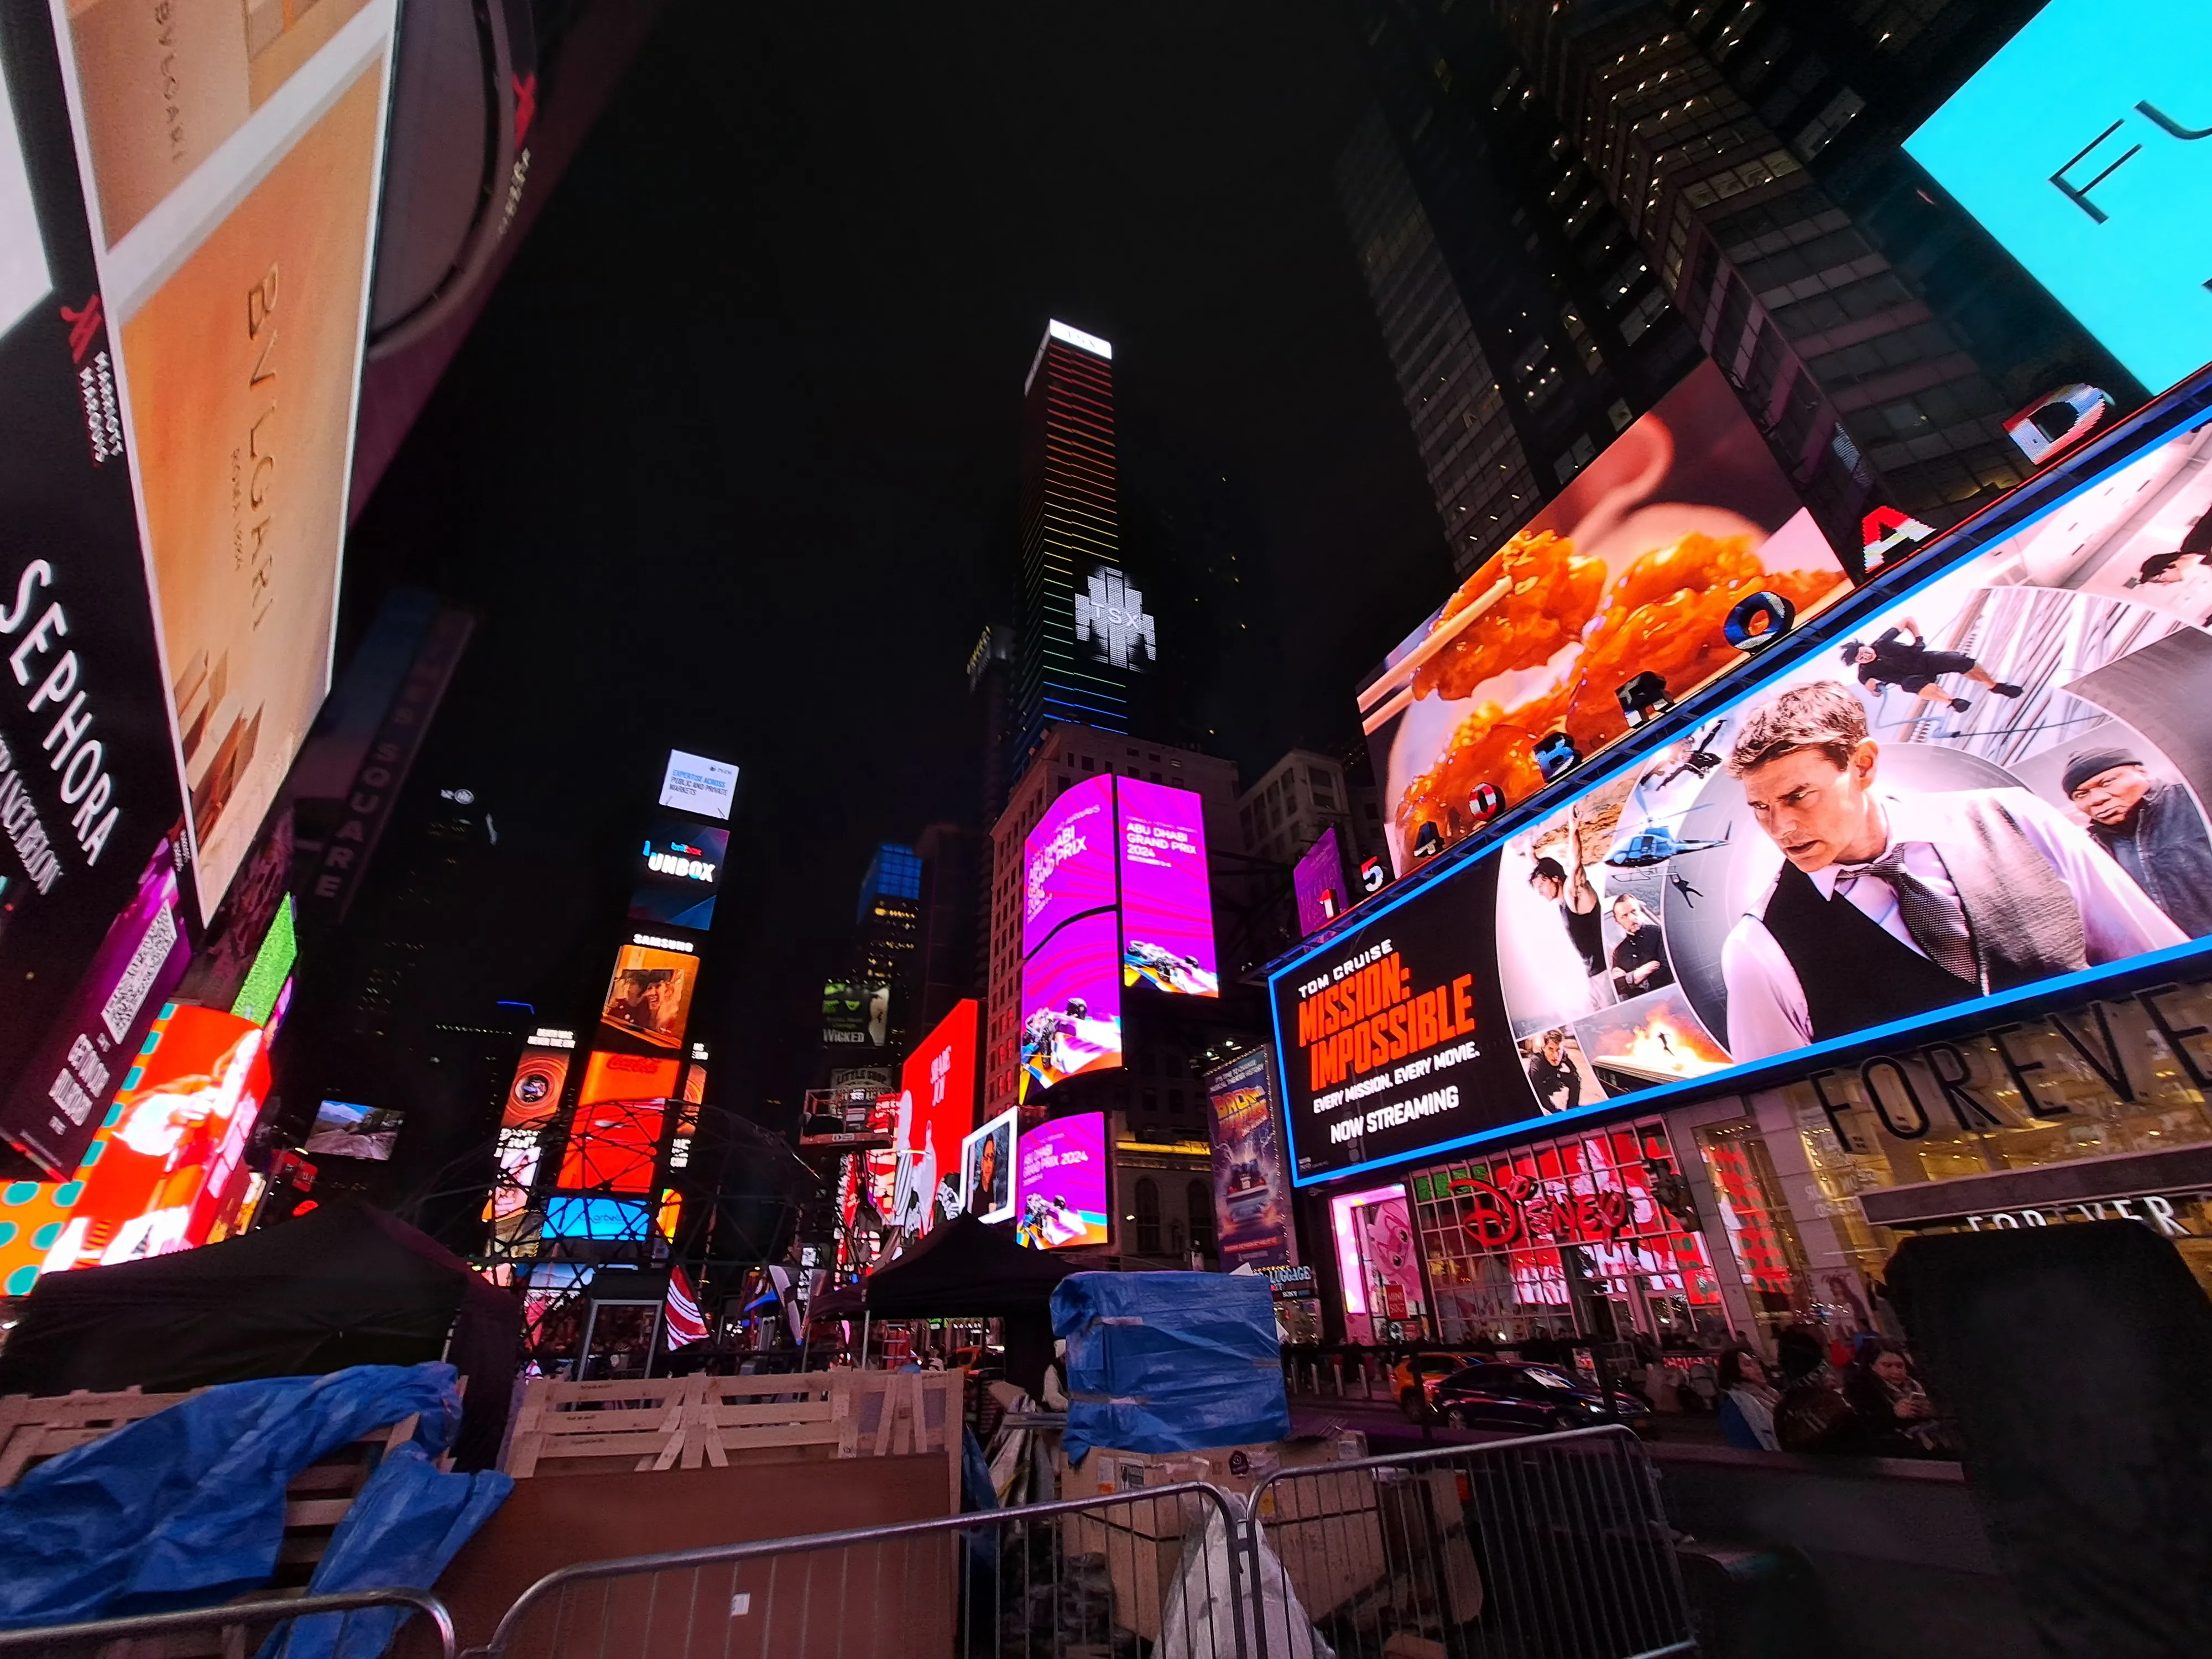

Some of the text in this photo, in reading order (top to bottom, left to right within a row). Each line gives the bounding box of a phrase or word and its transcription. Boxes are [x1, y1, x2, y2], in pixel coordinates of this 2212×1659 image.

[247, 261, 279, 631] BVLGARI
[1090, 601, 1140, 630] TSX
[0, 558, 120, 867] SEPHORA
[1044, 825, 1075, 863] DHABI
[1126, 822, 1151, 836] ABU
[1153, 827, 1188, 843] DHABI
[1126, 832, 1197, 854] GRAND PRIX
[1055, 836, 1087, 866] PRIX
[1126, 843, 1156, 858] 2024
[648, 852, 716, 883] UNBOX
[633, 933, 694, 953] SAMSUNG
[1298, 938, 1393, 999] TOM CRUISE
[1298, 952, 1411, 1048] MISSION:
[822, 1028, 865, 1043] WICKED
[1310, 973, 1475, 1092] IMPOSSIBLE
[1313, 1041, 1481, 1114] EVERY MISSION. EVERY MOVIE.
[1330, 1084, 1460, 1144] NOW STREAMING
[1060, 1150, 1089, 1165] 2024
[1269, 1265, 1312, 1284] LUGGAGE
